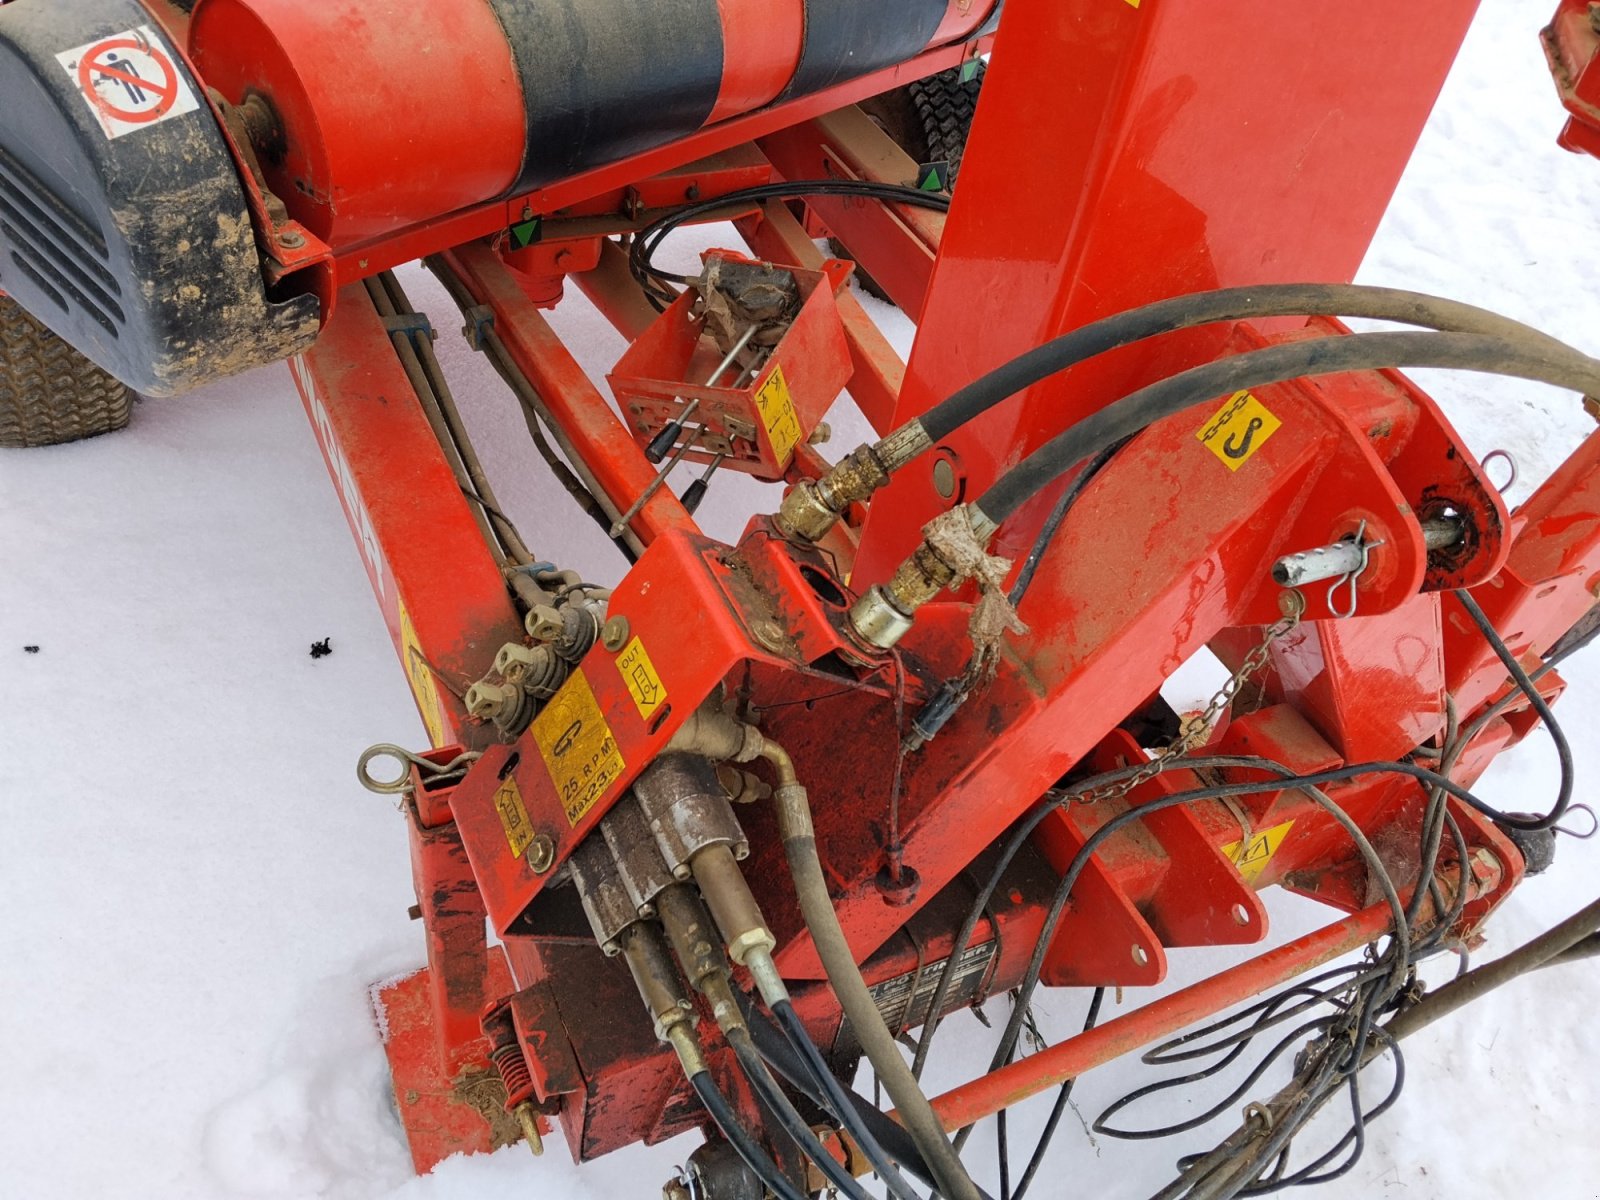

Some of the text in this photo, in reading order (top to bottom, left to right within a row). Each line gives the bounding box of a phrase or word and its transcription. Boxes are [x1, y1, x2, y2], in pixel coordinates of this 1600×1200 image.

[293, 353, 386, 602] NGER
[622, 646, 639, 669] OUT
[638, 669, 651, 694] OIL
[563, 776, 578, 800] 25
[516, 829, 527, 846] IN
